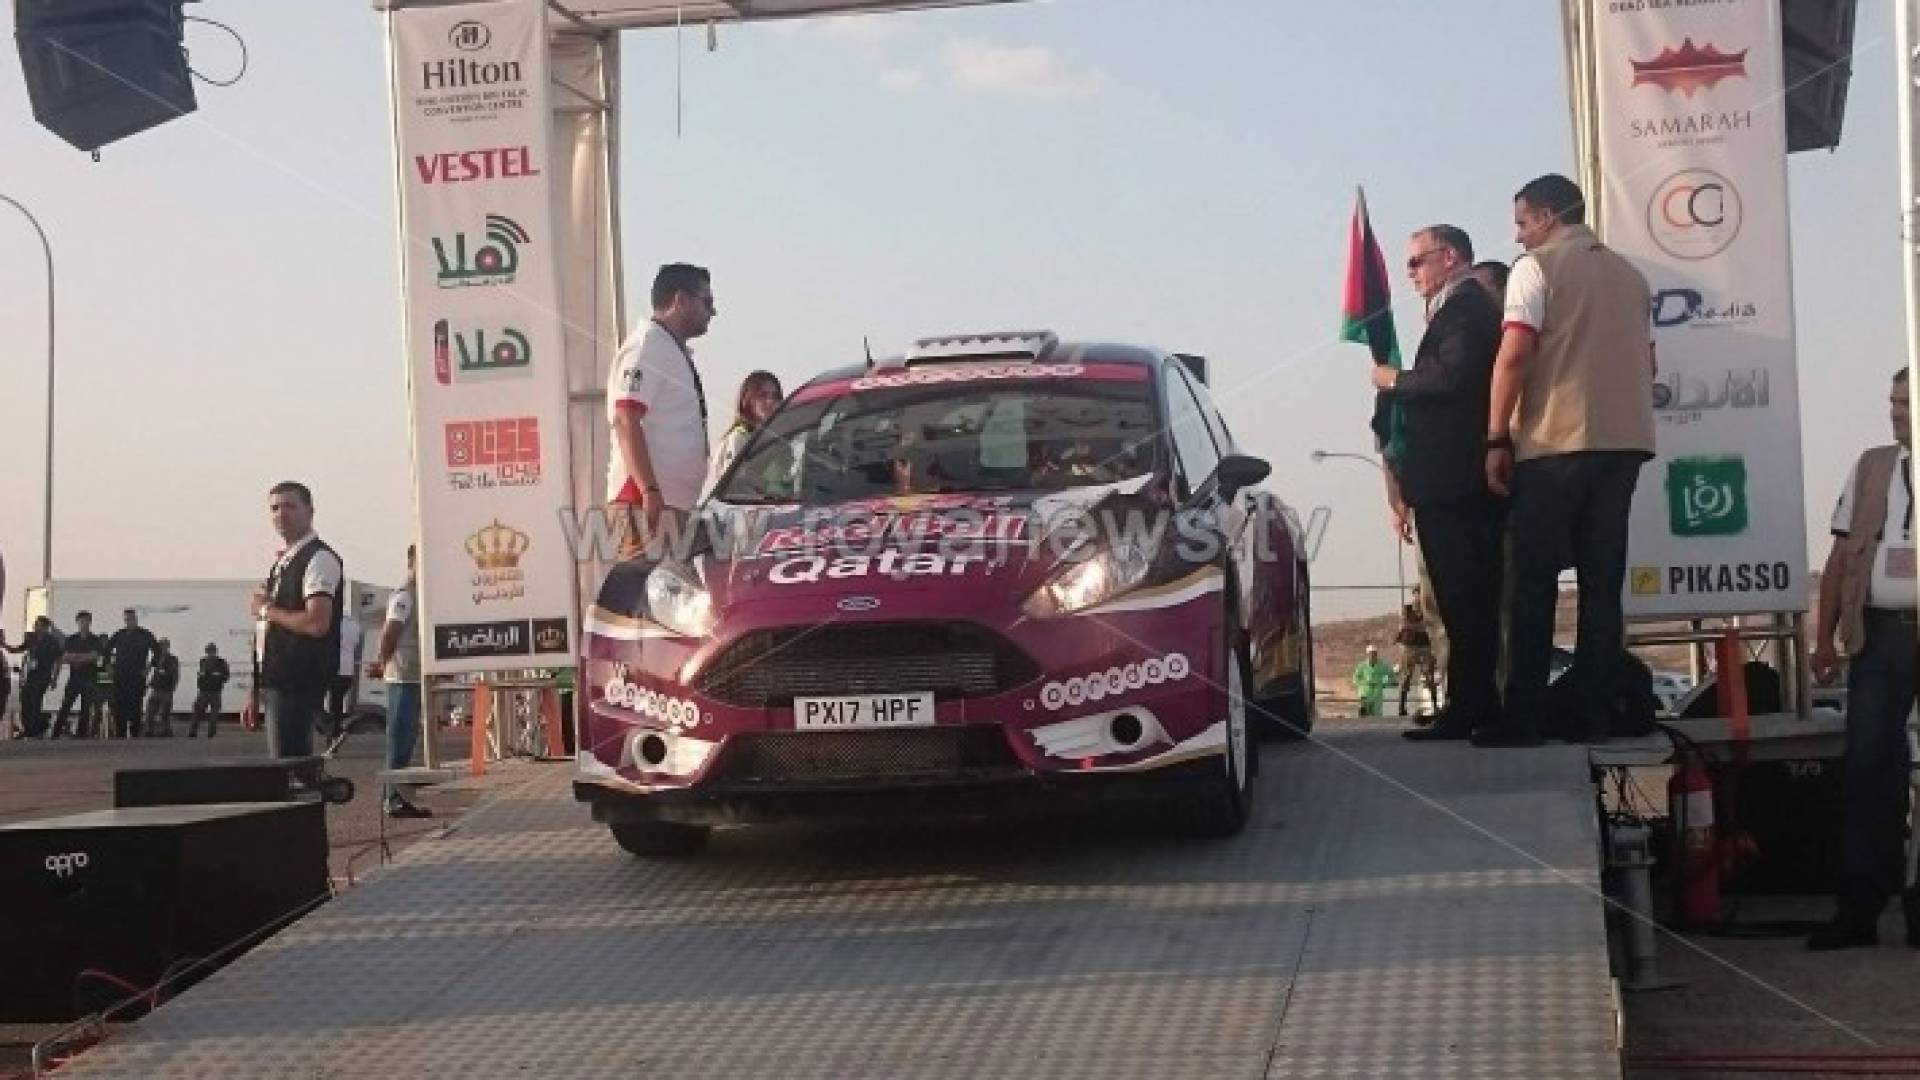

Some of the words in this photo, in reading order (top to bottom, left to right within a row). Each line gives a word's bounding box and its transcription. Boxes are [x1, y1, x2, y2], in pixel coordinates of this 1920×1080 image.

[422, 59, 523, 90] Hilton
[1631, 110, 1751, 138] SAMARAH
[415, 145, 541, 185] VESTEL
[768, 549, 985, 584] Qatar
[1668, 560, 1790, 596] PIKASSO
[1039, 652, 1189, 711] ooredoo
[804, 700, 861, 725] PX17
[871, 697, 922, 722] HPF
